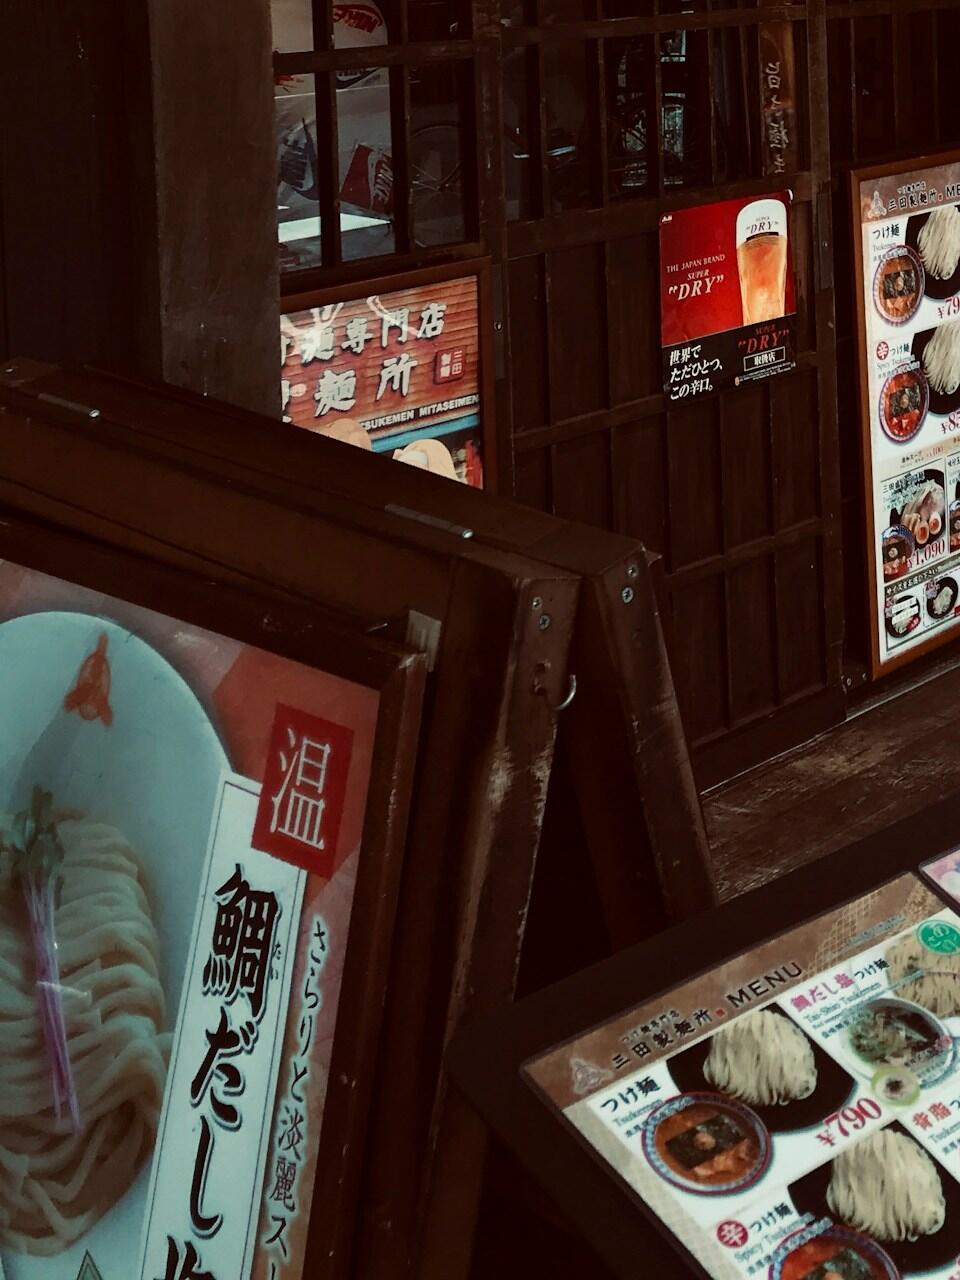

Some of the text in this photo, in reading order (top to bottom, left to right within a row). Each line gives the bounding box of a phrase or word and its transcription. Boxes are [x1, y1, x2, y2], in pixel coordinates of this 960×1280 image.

[872, 222, 901, 240] つけ麺
[667, 254, 725, 273] THE JAPAN BRAND
[687, 269, 710, 280] SUPER
[281, 302, 448, 367] 麺専門店
[669, 345, 702, 366] 世界で
[670, 358, 724, 383] ただひとつ、
[282, 352, 419, 417] 麺所
[670, 379, 714, 401] この辛口。
[270, 727, 332, 851] 温
[612, 961, 803, 1069] 三田製麺所 MENU
[600, 1076, 661, 1113] つけ麺
[815, 1097, 883, 1147] ¥790
[748, 1202, 793, 1234] つけ麺
